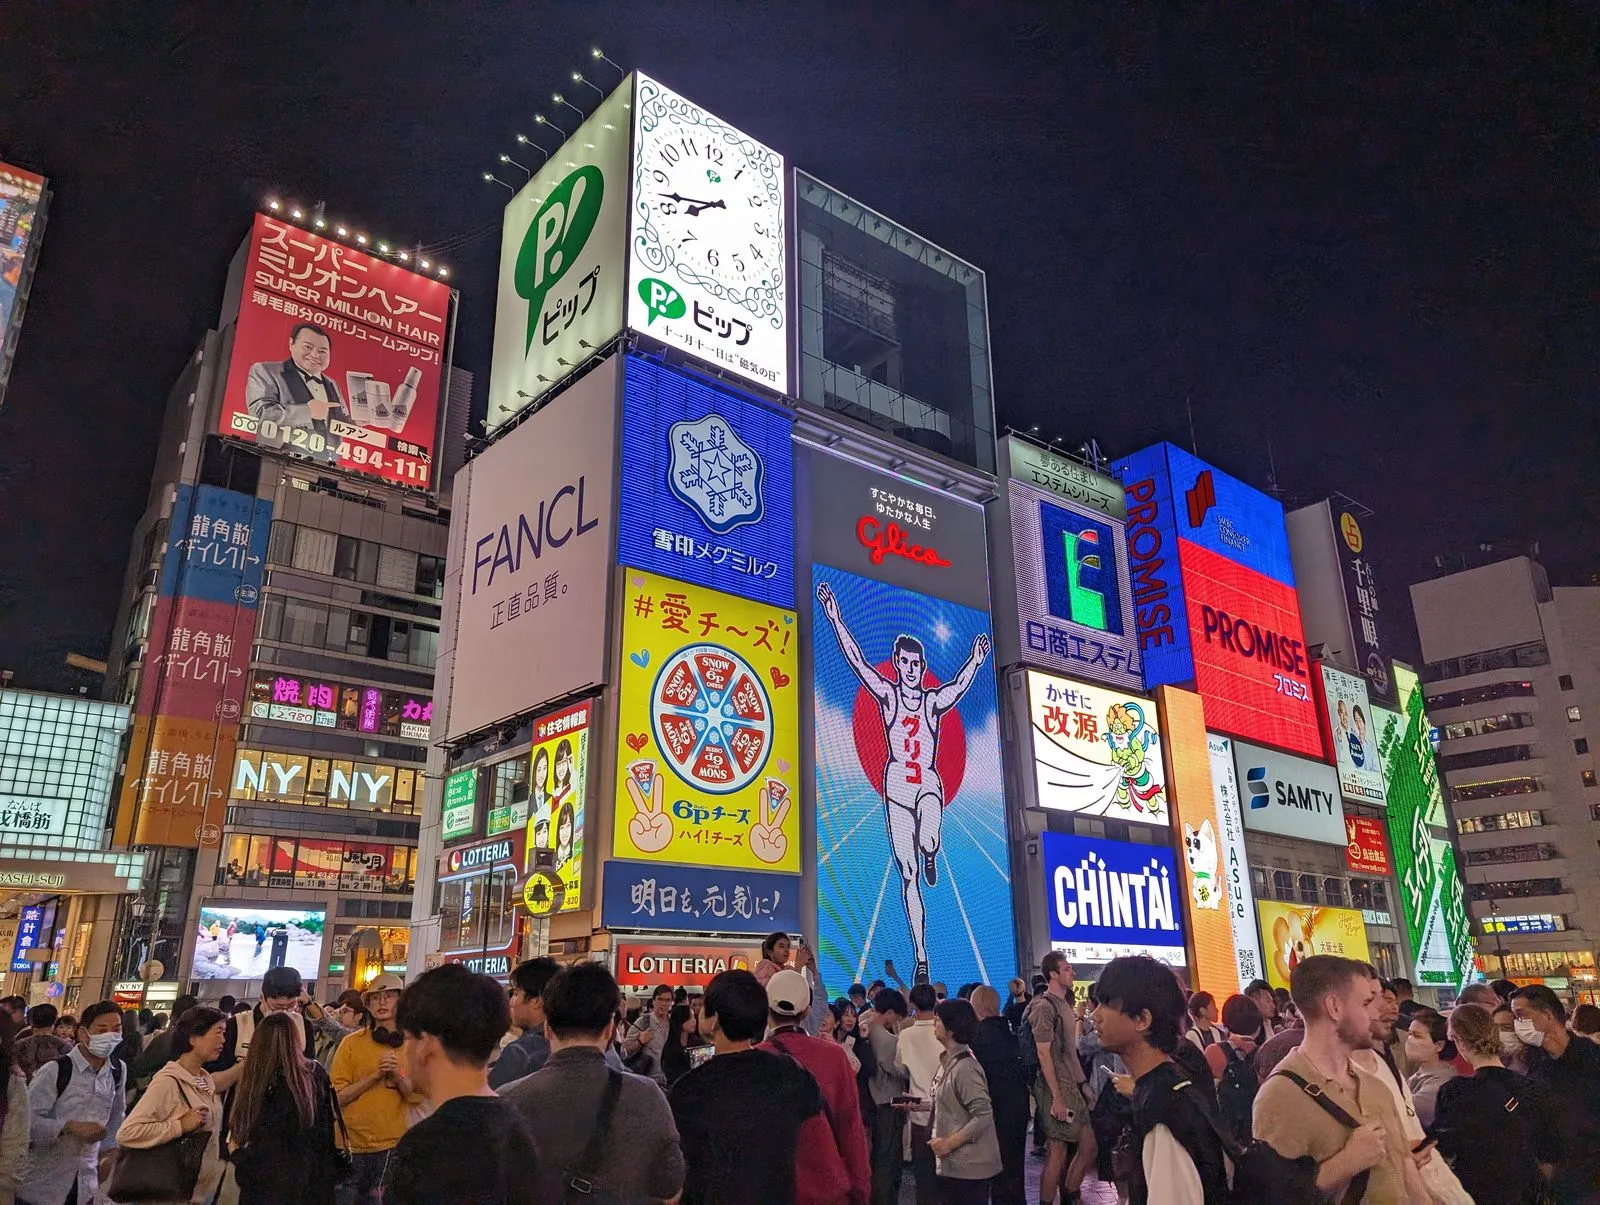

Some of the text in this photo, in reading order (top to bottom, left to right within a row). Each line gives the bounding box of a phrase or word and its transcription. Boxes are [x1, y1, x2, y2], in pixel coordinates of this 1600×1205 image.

[659, 144, 679, 167] 10
[681, 138, 698, 156] 11
[704, 144, 724, 166] 12
[653, 170, 669, 186] 9
[734, 169, 744, 180] 1
[660, 202, 677, 216] 8
[747, 195, 762, 207] 2
[682, 230, 698, 243] 7
[754, 222, 769, 238] 3
[261, 222, 368, 273] スーパー
[707, 249, 719, 267] 6
[732, 253, 744, 272] 5
[750, 243, 763, 260] 4
[258, 245, 442, 323] ミリオンヘアー
[254, 270, 440, 346] SUPER MILLION HAIR
[543, 265, 600, 346] ピップ
[694, 300, 752, 346] ピップ
[333, 422, 368, 439] ルアン
[260, 420, 428, 482] 0120-494-111
[870, 487, 937, 519] すこやかな毎日、
[1032, 470, 1111, 512] エステムシリーズ
[191, 513, 250, 546] 龍角散
[876, 501, 931, 530] ゆたかな人生
[472, 475, 598, 595] FANCL
[857, 515, 952, 567] Glico
[652, 528, 778, 579] 雪印メグミルク
[1123, 478, 1175, 650] PROMISE
[490, 570, 568, 630] 正直品質。
[170, 626, 232, 659] 龍角散
[1201, 604, 1306, 677] PROMISE
[702, 656, 730, 671] SNOW
[274, 677, 333, 709] 焼肉
[665, 665, 686, 698] SNOW
[1046, 684, 1092, 709] かぜに
[1273, 673, 1310, 700] プロミス
[744, 682, 762, 714] SNOW
[401, 730, 429, 739] RIKIMA
[547, 709, 587, 736] 住宅情報館
[663, 721, 684, 755] SNOW
[1042, 704, 1099, 743] 改源
[744, 736, 761, 767] SNOW
[901, 714, 922, 785] グリコ
[1209, 741, 1224, 753] Asue
[148, 748, 213, 780] 龍角散
[700, 767, 727, 780] SNOW
[236, 760, 390, 803] NY NY
[1275, 780, 1333, 815] SAMTY
[7, 800, 42, 811] なんば
[343, 851, 382, 869] 風月
[462, 842, 510, 866] LOTTERIA
[1220, 784, 1245, 918] 株式会社 Asue
[631, 878, 781, 921] 明日を、元気に!
[628, 956, 726, 974] LOTTERIA
